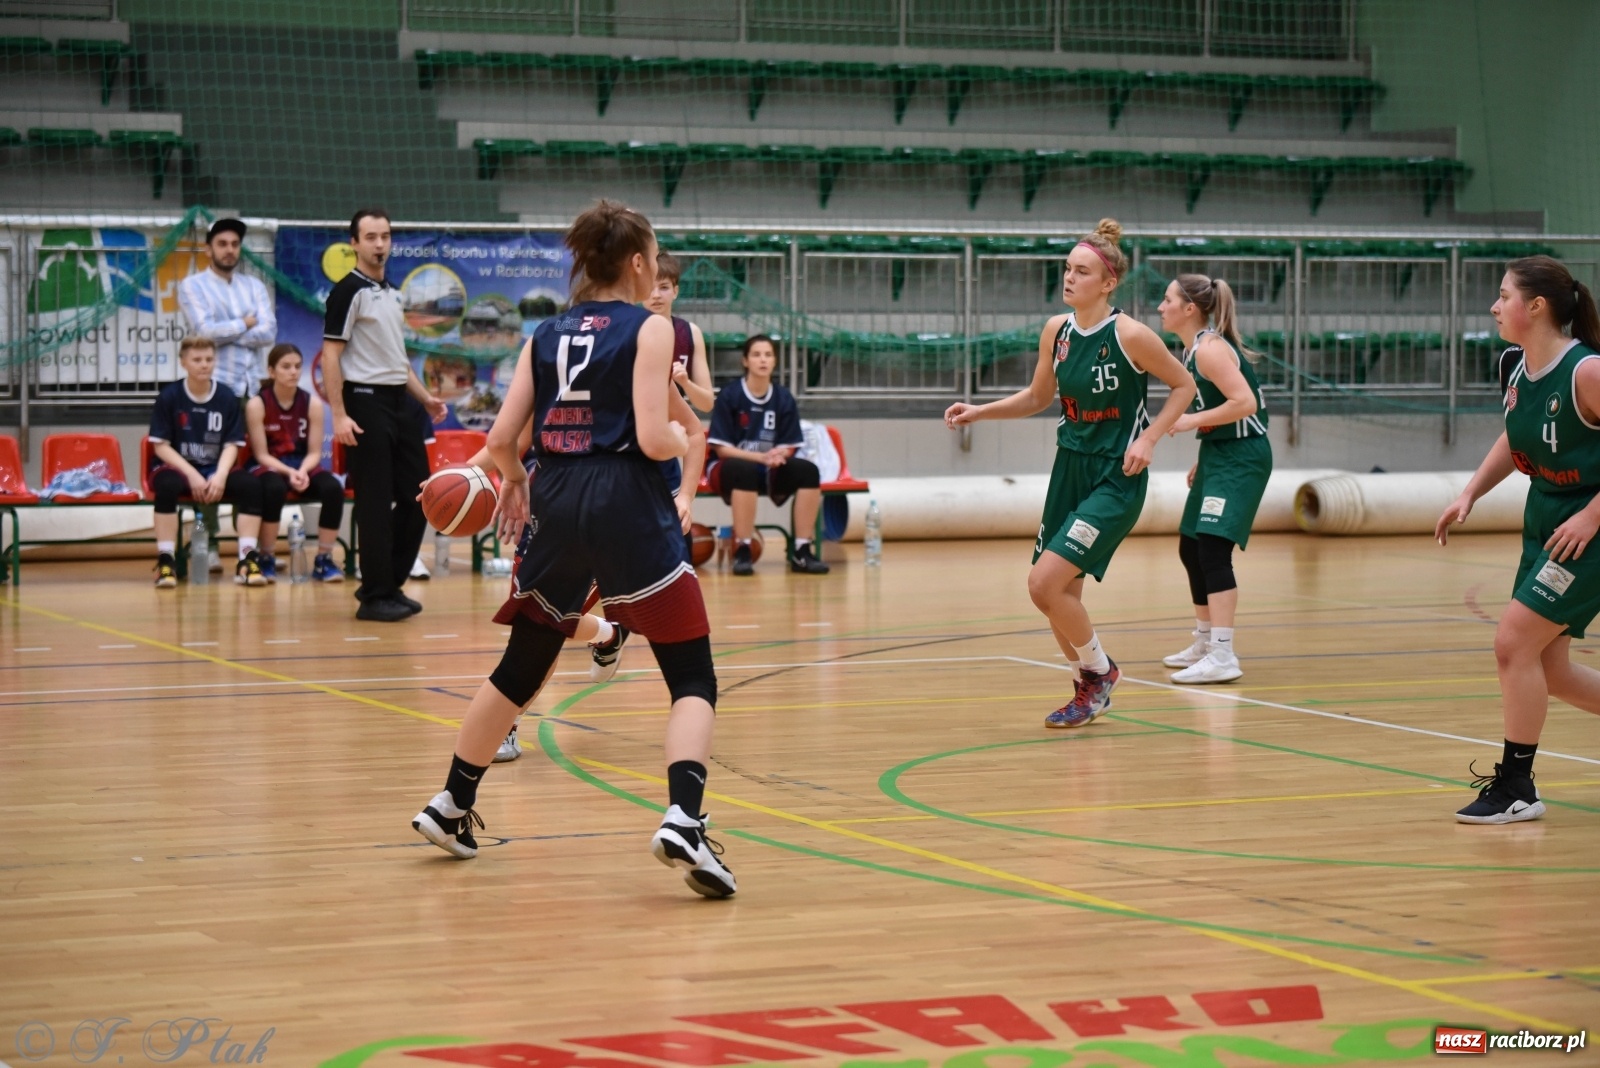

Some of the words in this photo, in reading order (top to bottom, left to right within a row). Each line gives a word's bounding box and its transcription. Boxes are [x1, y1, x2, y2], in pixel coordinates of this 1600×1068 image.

[556, 335, 595, 401] 12
[1091, 362, 1119, 394] 35
[208, 411, 223, 432] 10
[1542, 421, 1558, 453] 4
[1532, 585, 1556, 602] COLO
